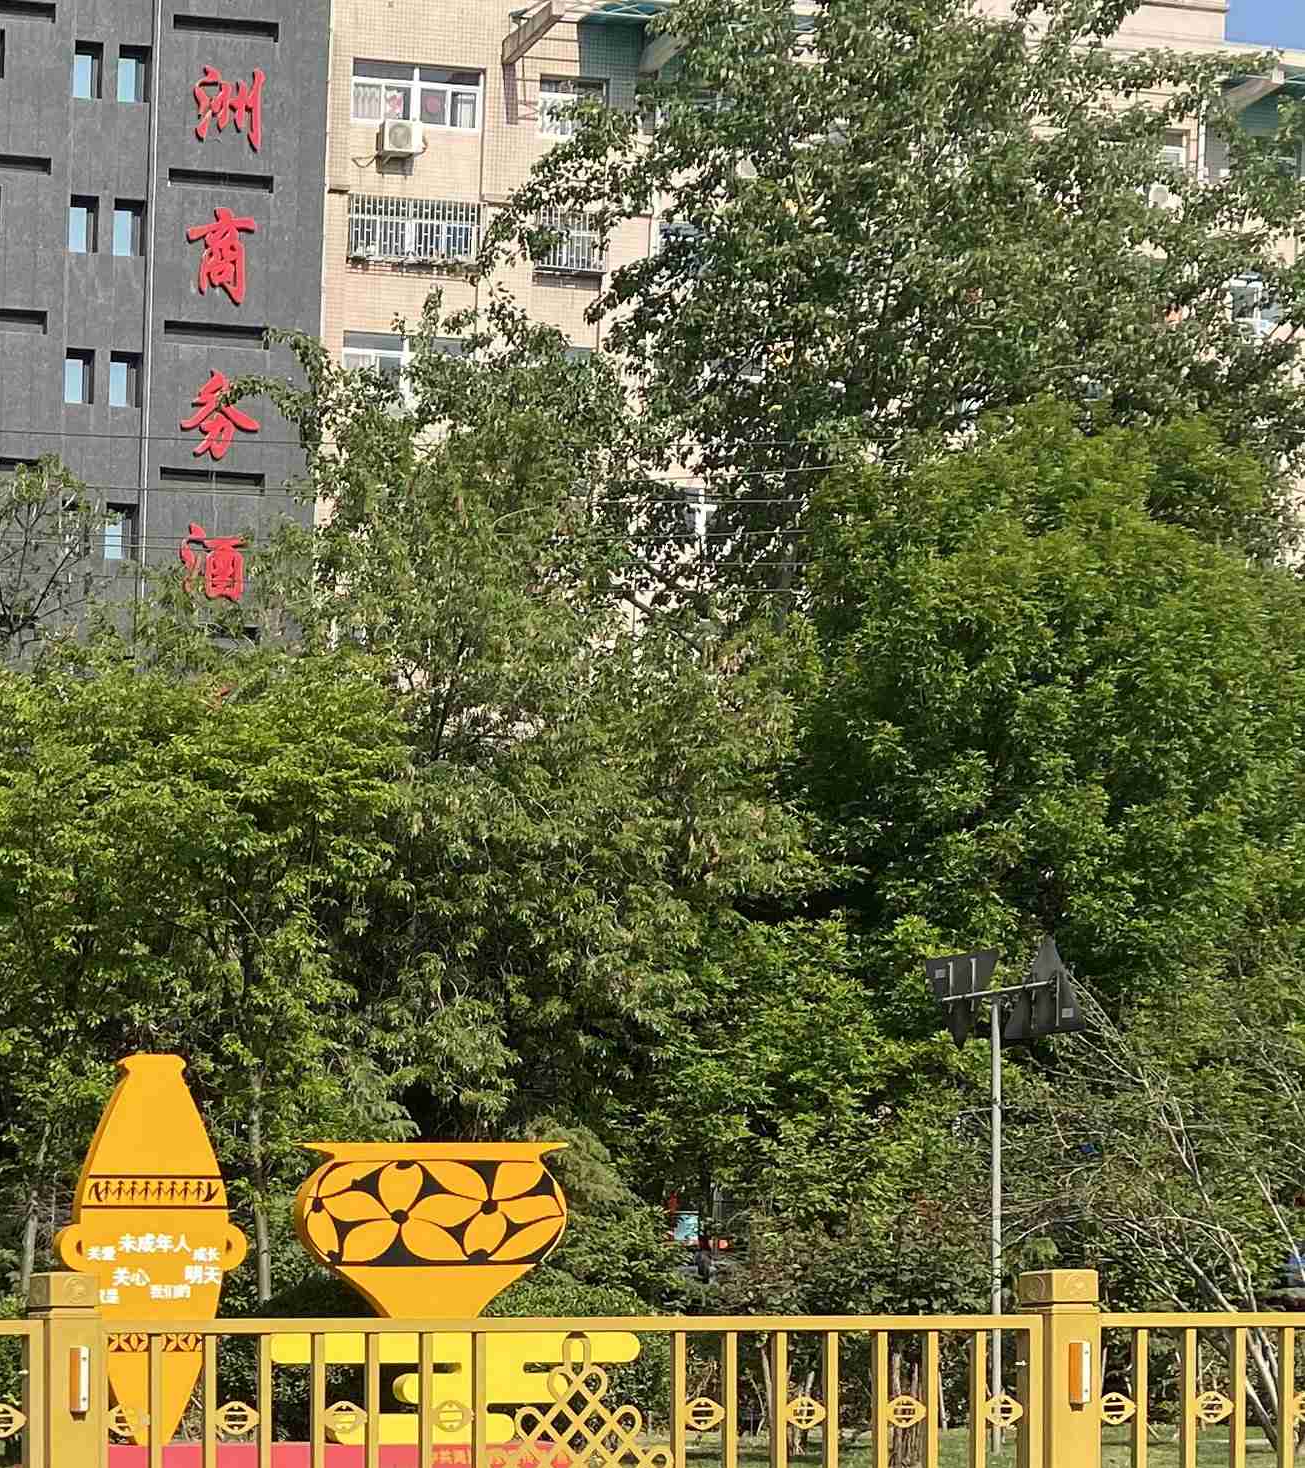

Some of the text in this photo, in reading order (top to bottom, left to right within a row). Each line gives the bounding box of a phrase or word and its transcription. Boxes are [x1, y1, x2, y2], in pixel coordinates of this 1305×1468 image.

[180, 65, 266, 602] 洲商务酒
[87, 1233, 221, 1261] 关爱 未成年人 成长
[112, 1265, 222, 1286] 关心 明天
